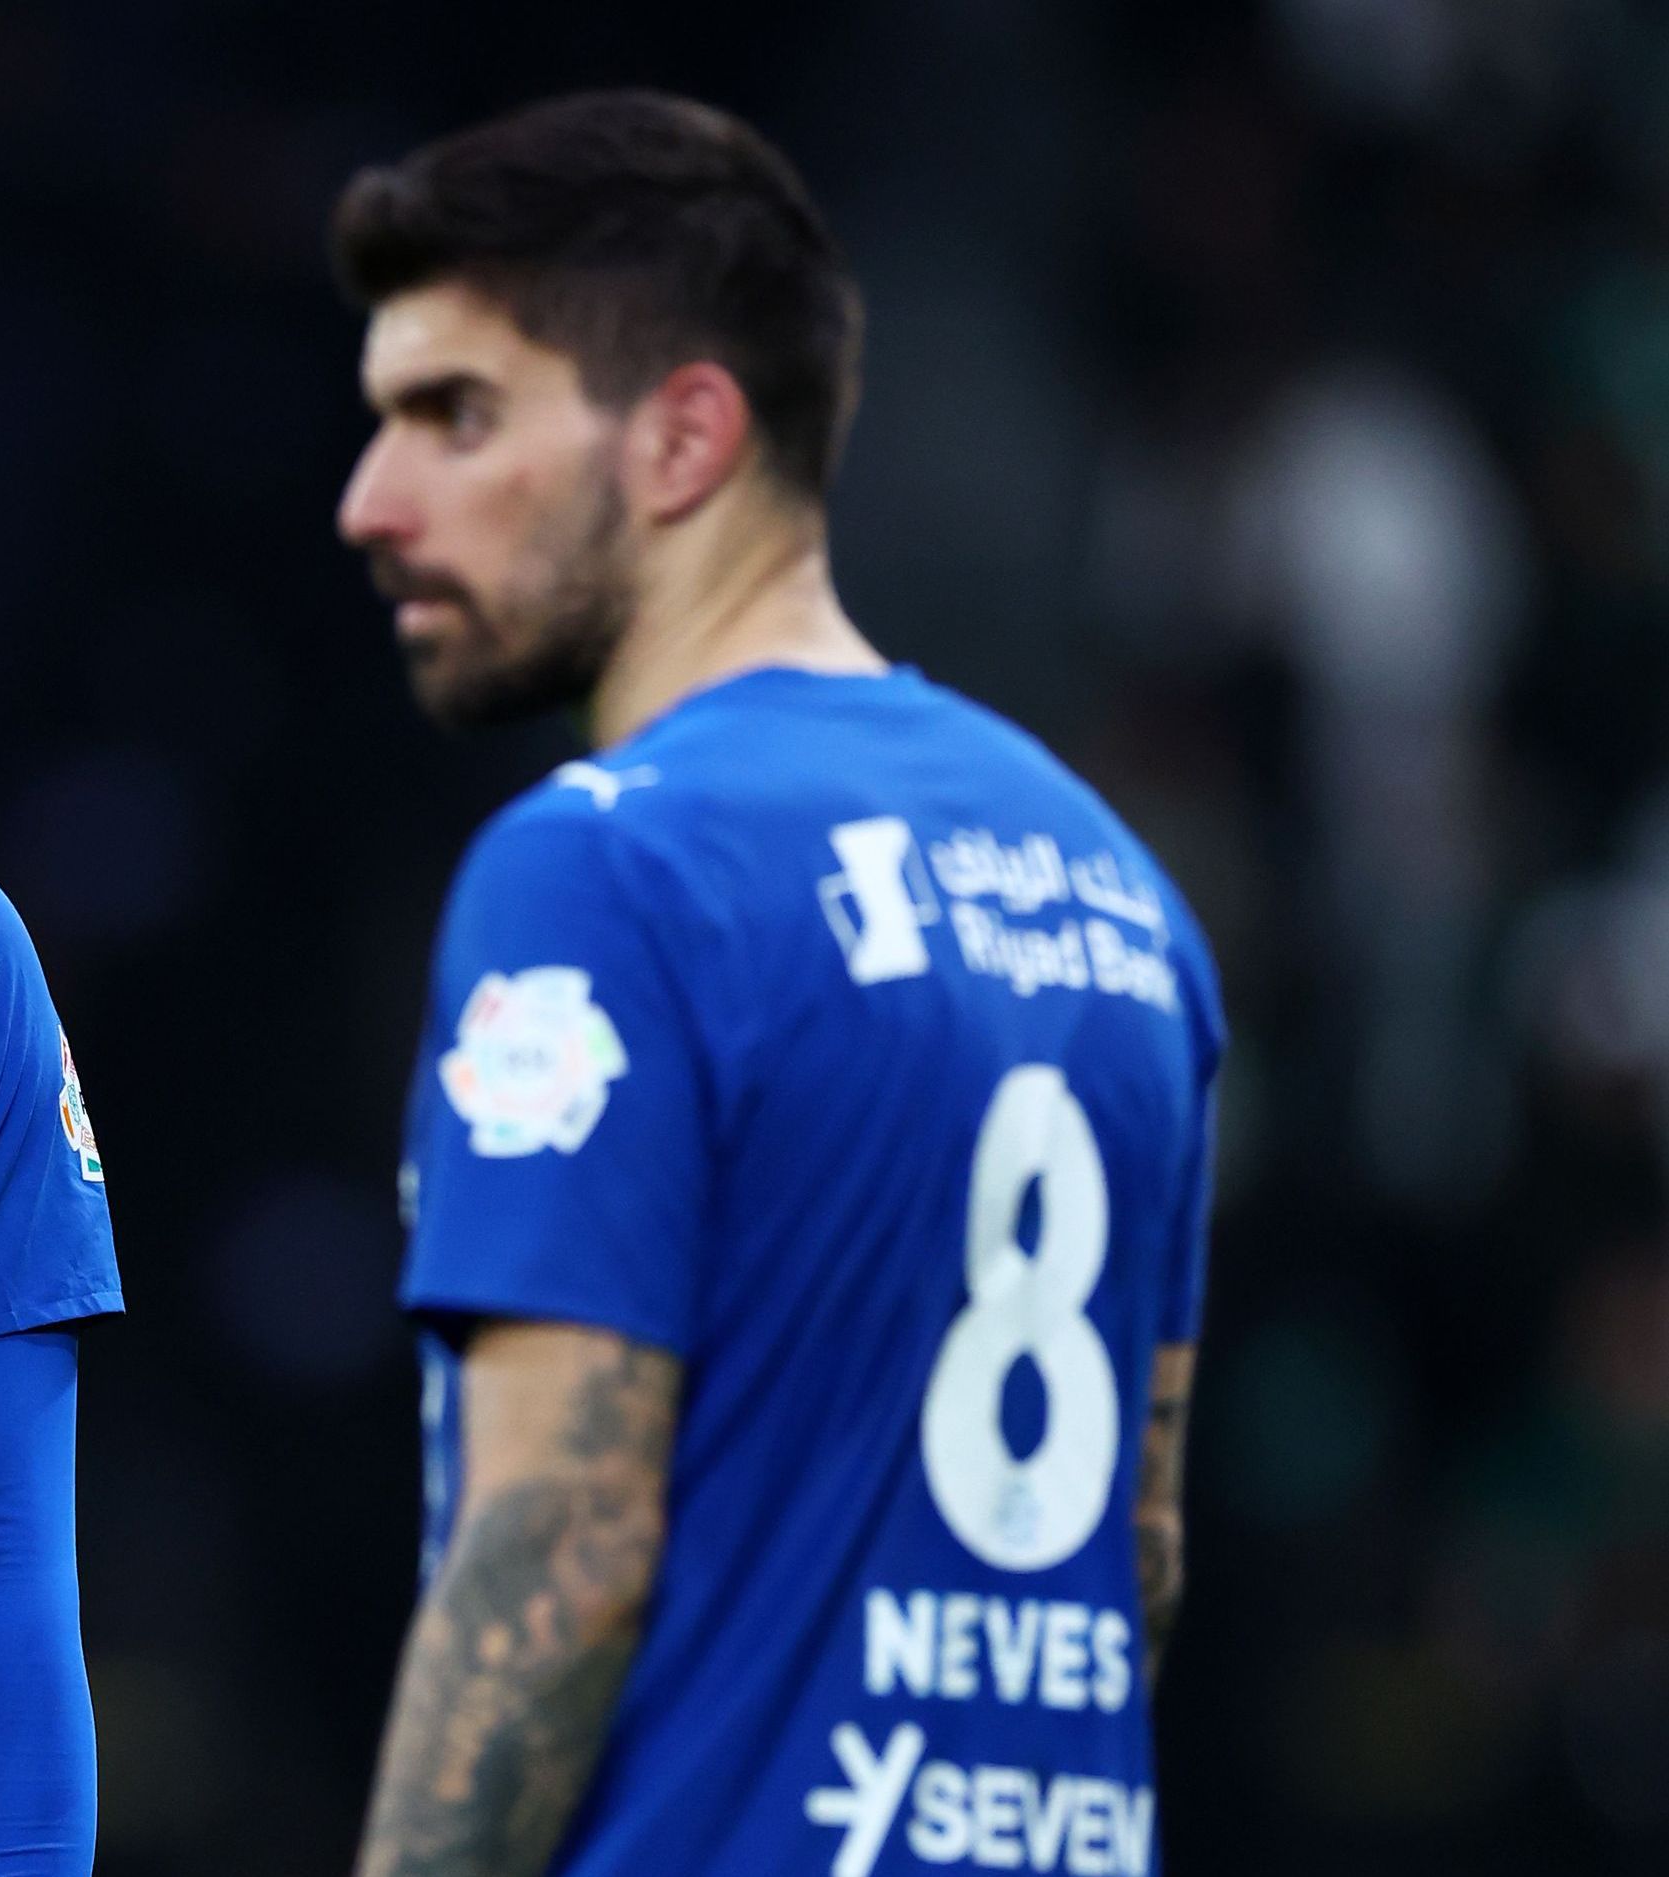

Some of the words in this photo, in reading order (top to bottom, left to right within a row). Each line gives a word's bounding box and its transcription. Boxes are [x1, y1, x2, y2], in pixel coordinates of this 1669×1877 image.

[947, 899, 1090, 998] Riyad
[1083, 917, 1178, 1013] Ban
[921, 1063, 1120, 1573] 8
[864, 1587, 1130, 1713] NEVES
